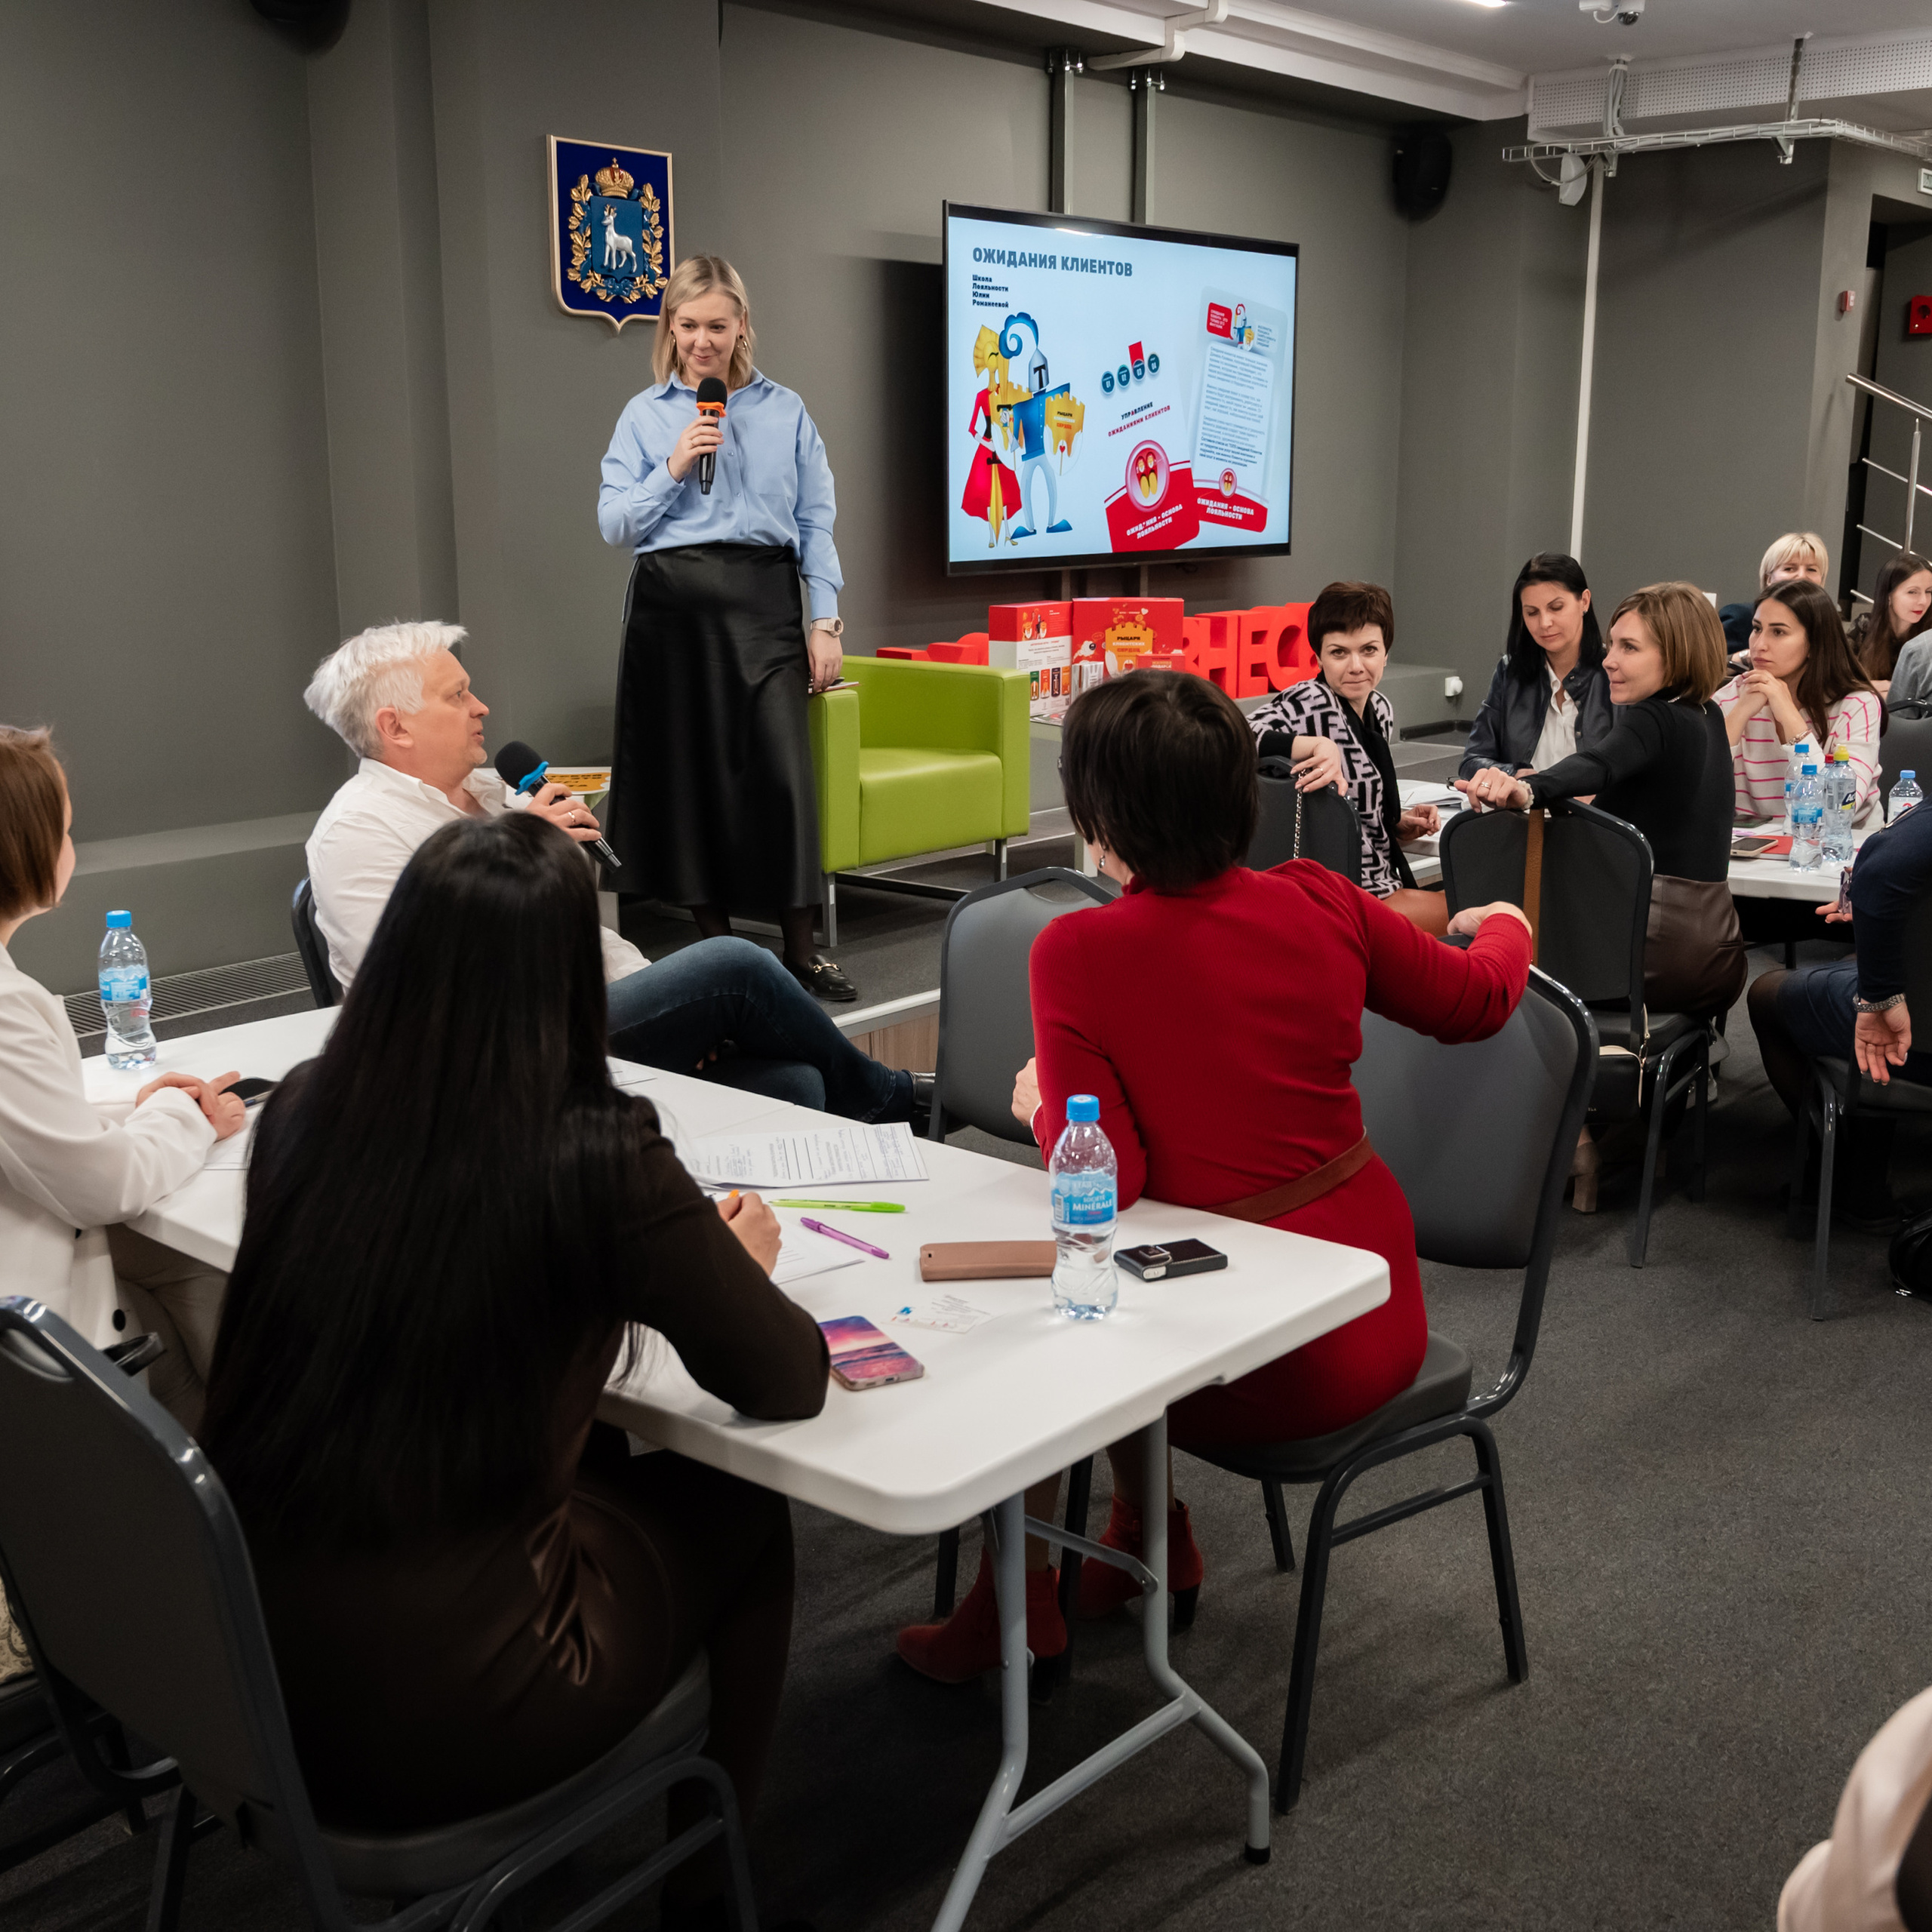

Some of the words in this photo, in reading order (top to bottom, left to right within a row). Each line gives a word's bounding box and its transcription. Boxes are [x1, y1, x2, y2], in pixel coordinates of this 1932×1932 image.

[972, 247, 1057, 270] ОЖИДАНИЯ
[1060, 256, 1133, 277] КЛИЕНТОВ
[972, 274, 992, 283] Школа
[972, 282, 1009, 292] Лояльности
[1121, 401, 1153, 420] УПРАВЛЕНИЕ
[1108, 417, 1143, 437] ОЖИДАНИЯМИ
[1145, 405, 1171, 421] КЛИЕНТОВ
[1161, 503, 1183, 518] ОСНОВА
[1197, 497, 1228, 510] ОЖИДАНИЯ
[1232, 505, 1254, 515] ОСНОВА
[1206, 507, 1243, 520] ЛОЯЛЬНОСТИ
[1137, 516, 1173, 539] ЛОЯЛЬНОСТИ
